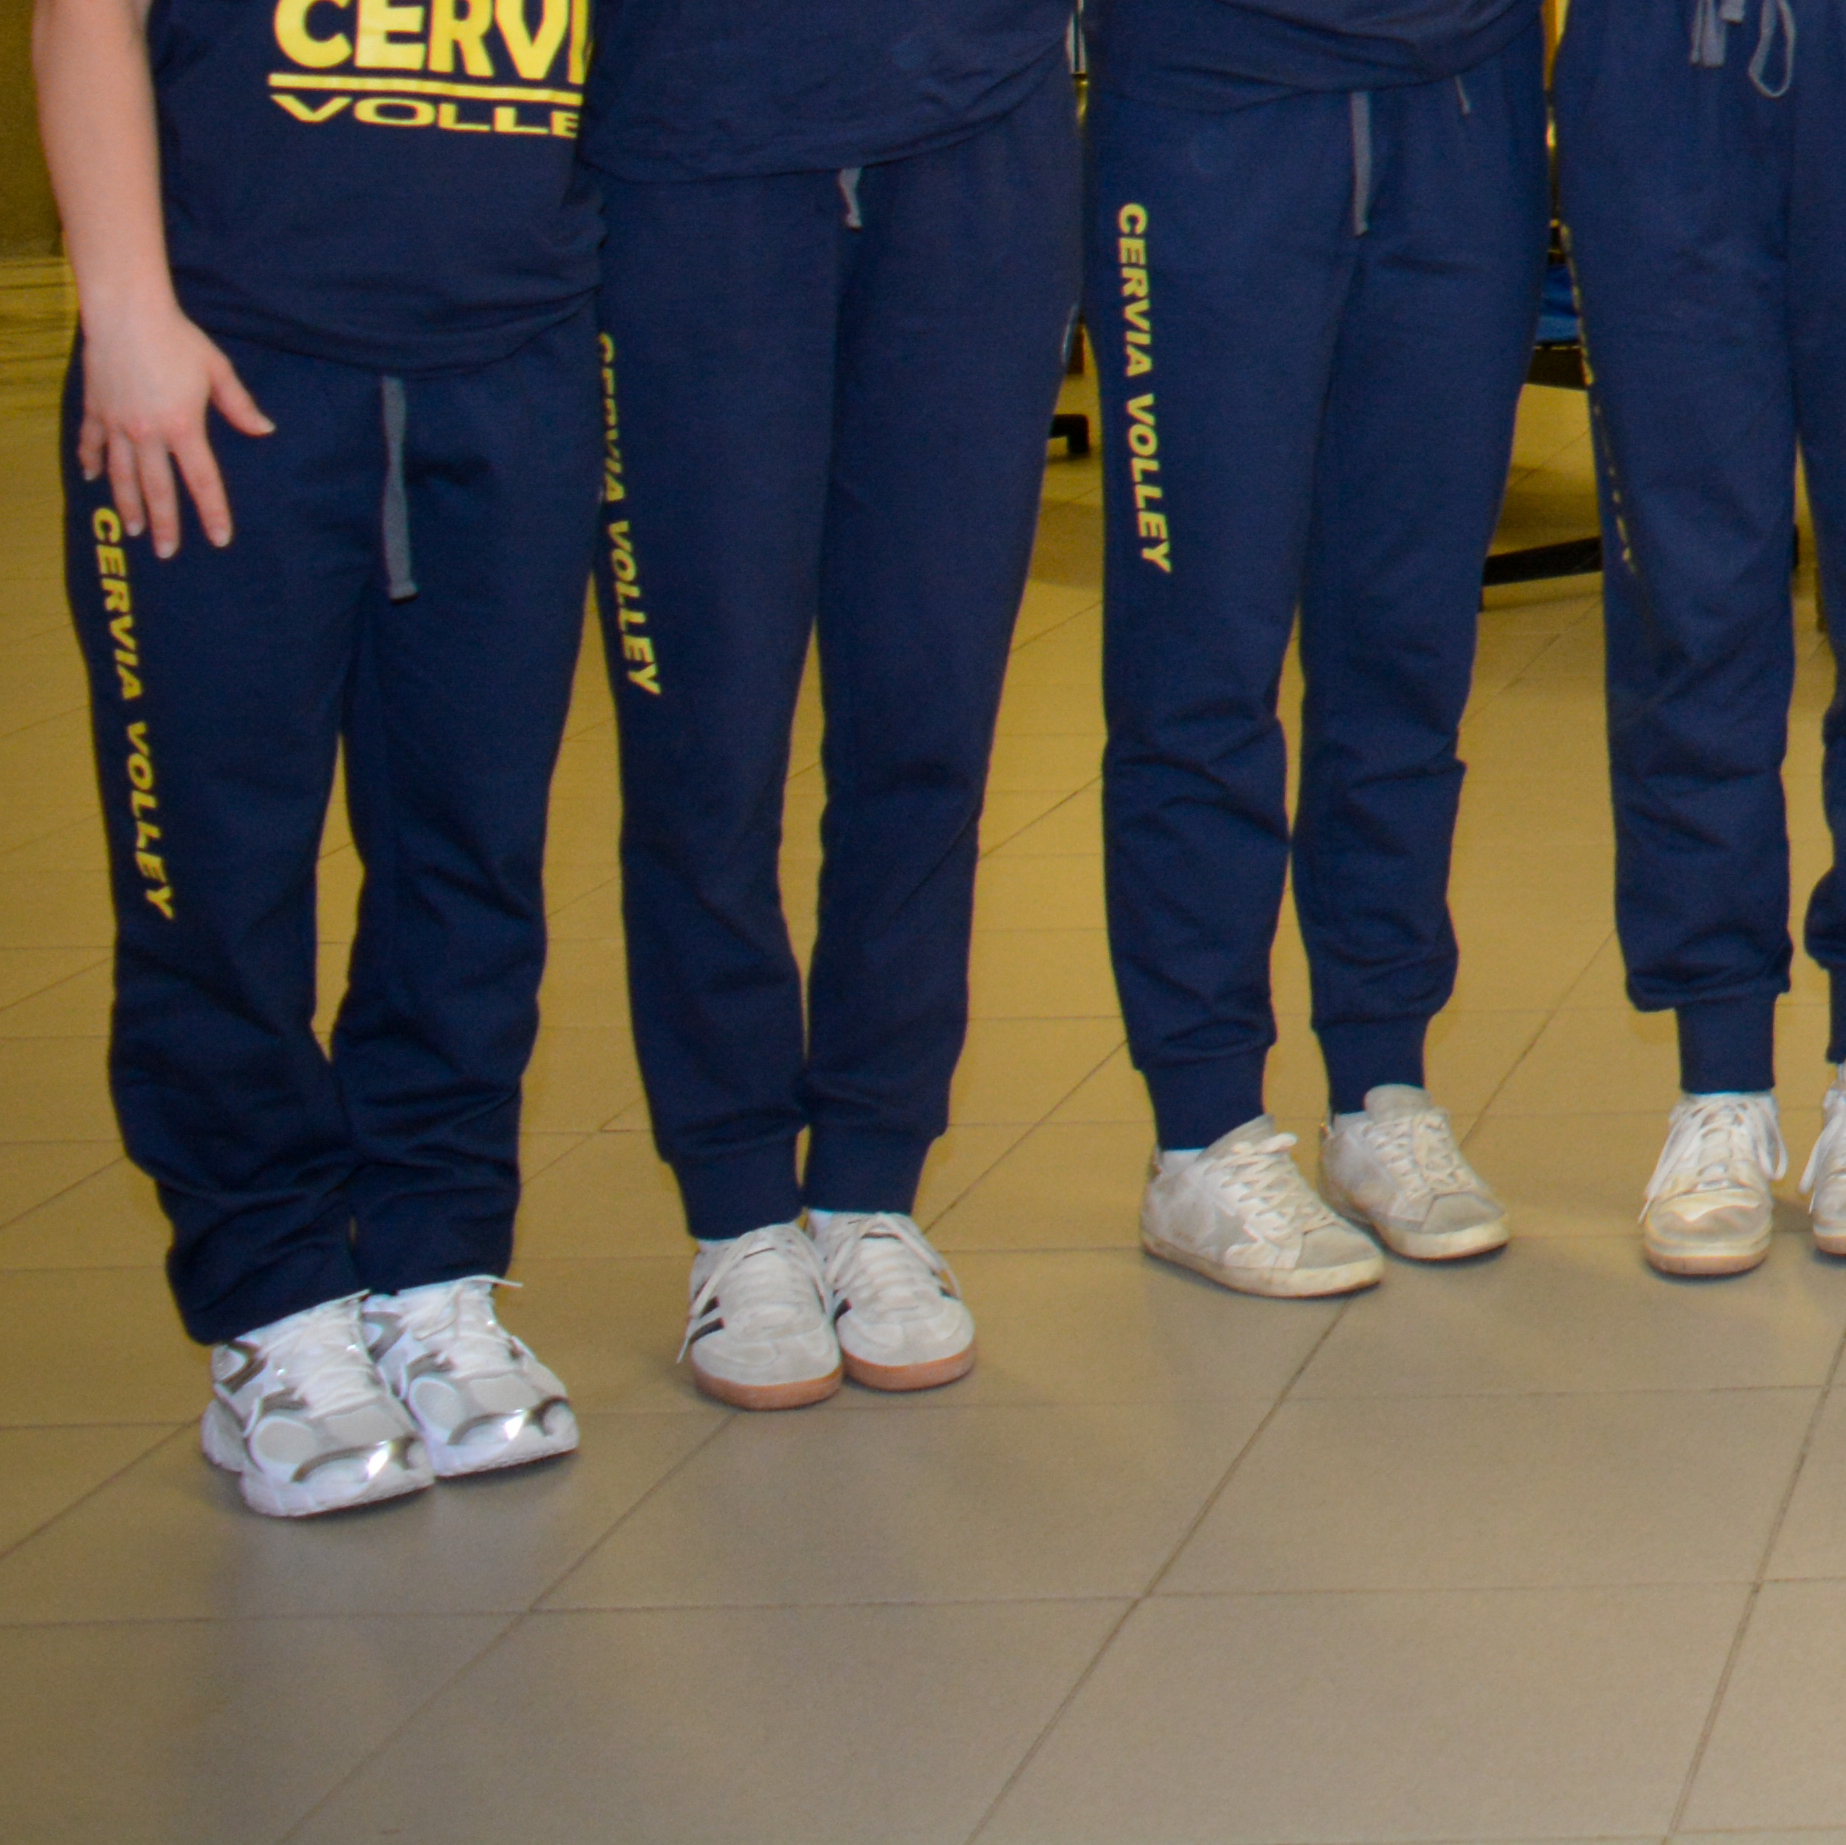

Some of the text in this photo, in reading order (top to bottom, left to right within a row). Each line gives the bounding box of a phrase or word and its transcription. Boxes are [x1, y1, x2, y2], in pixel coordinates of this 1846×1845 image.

[270, 93, 580, 139] VOLLE
[1118, 202, 1172, 574] CERVIA VOLLEY
[91, 507, 175, 920] CERVIA VOLLEY
[608, 520, 661, 695] VOLLEY
